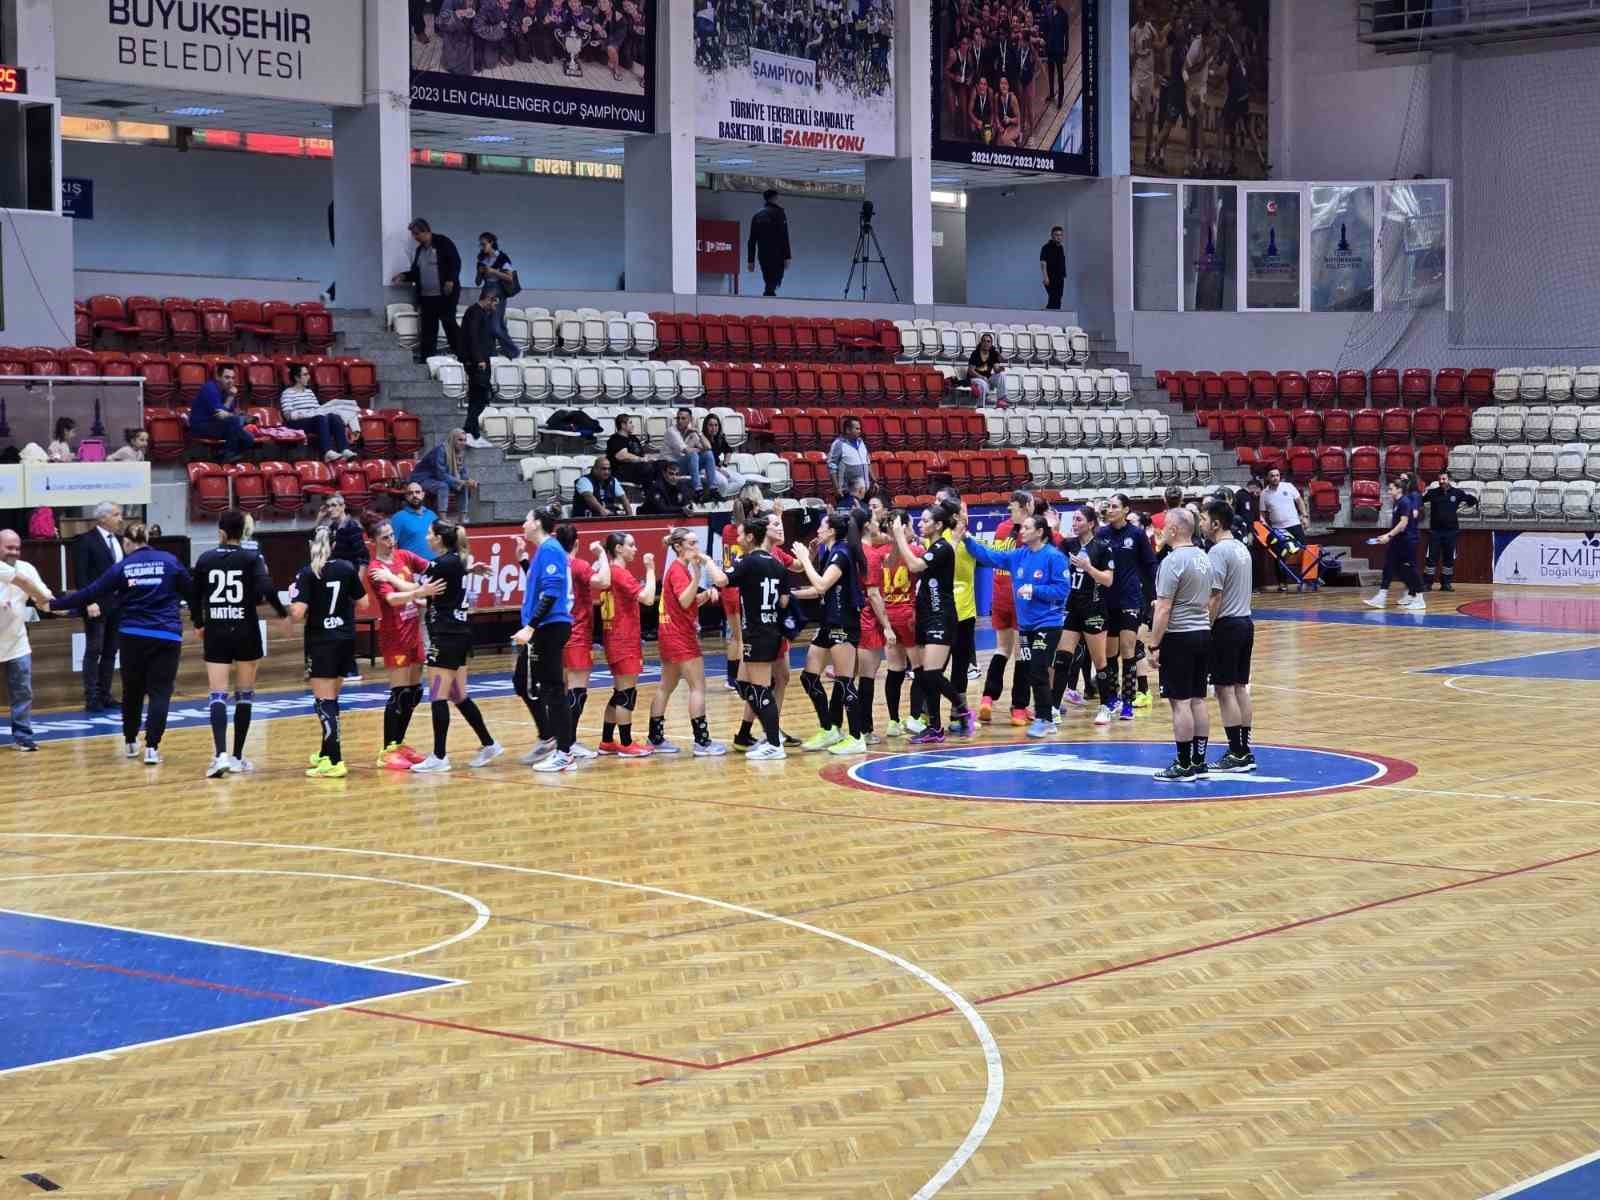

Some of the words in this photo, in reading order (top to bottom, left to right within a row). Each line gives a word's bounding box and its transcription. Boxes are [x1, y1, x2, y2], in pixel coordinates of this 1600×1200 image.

[118, 37, 303, 80] BELEDİYESİ
[752, 60, 814, 86] ŞAMPİYON
[411, 86, 440, 102] 2023
[442, 89, 467, 105] LEN
[470, 92, 550, 113] CHALLENGER
[553, 101, 577, 116] CUP
[579, 103, 645, 123] ŞAMPİYONU
[730, 98, 765, 121] TÜRKİYE
[766, 104, 812, 126] TEKERLEKLİ
[814, 109, 855, 130] SANDALYE
[719, 121, 766, 143] BASKETBOL
[971, 151, 1054, 170] 2021/2022/2023/2024
[208, 569, 243, 603] 25
[1071, 572, 1084, 590] 17
[1540, 566, 1572, 579] Doğal
[326, 580, 341, 615] 7
[760, 576, 780, 610] 15
